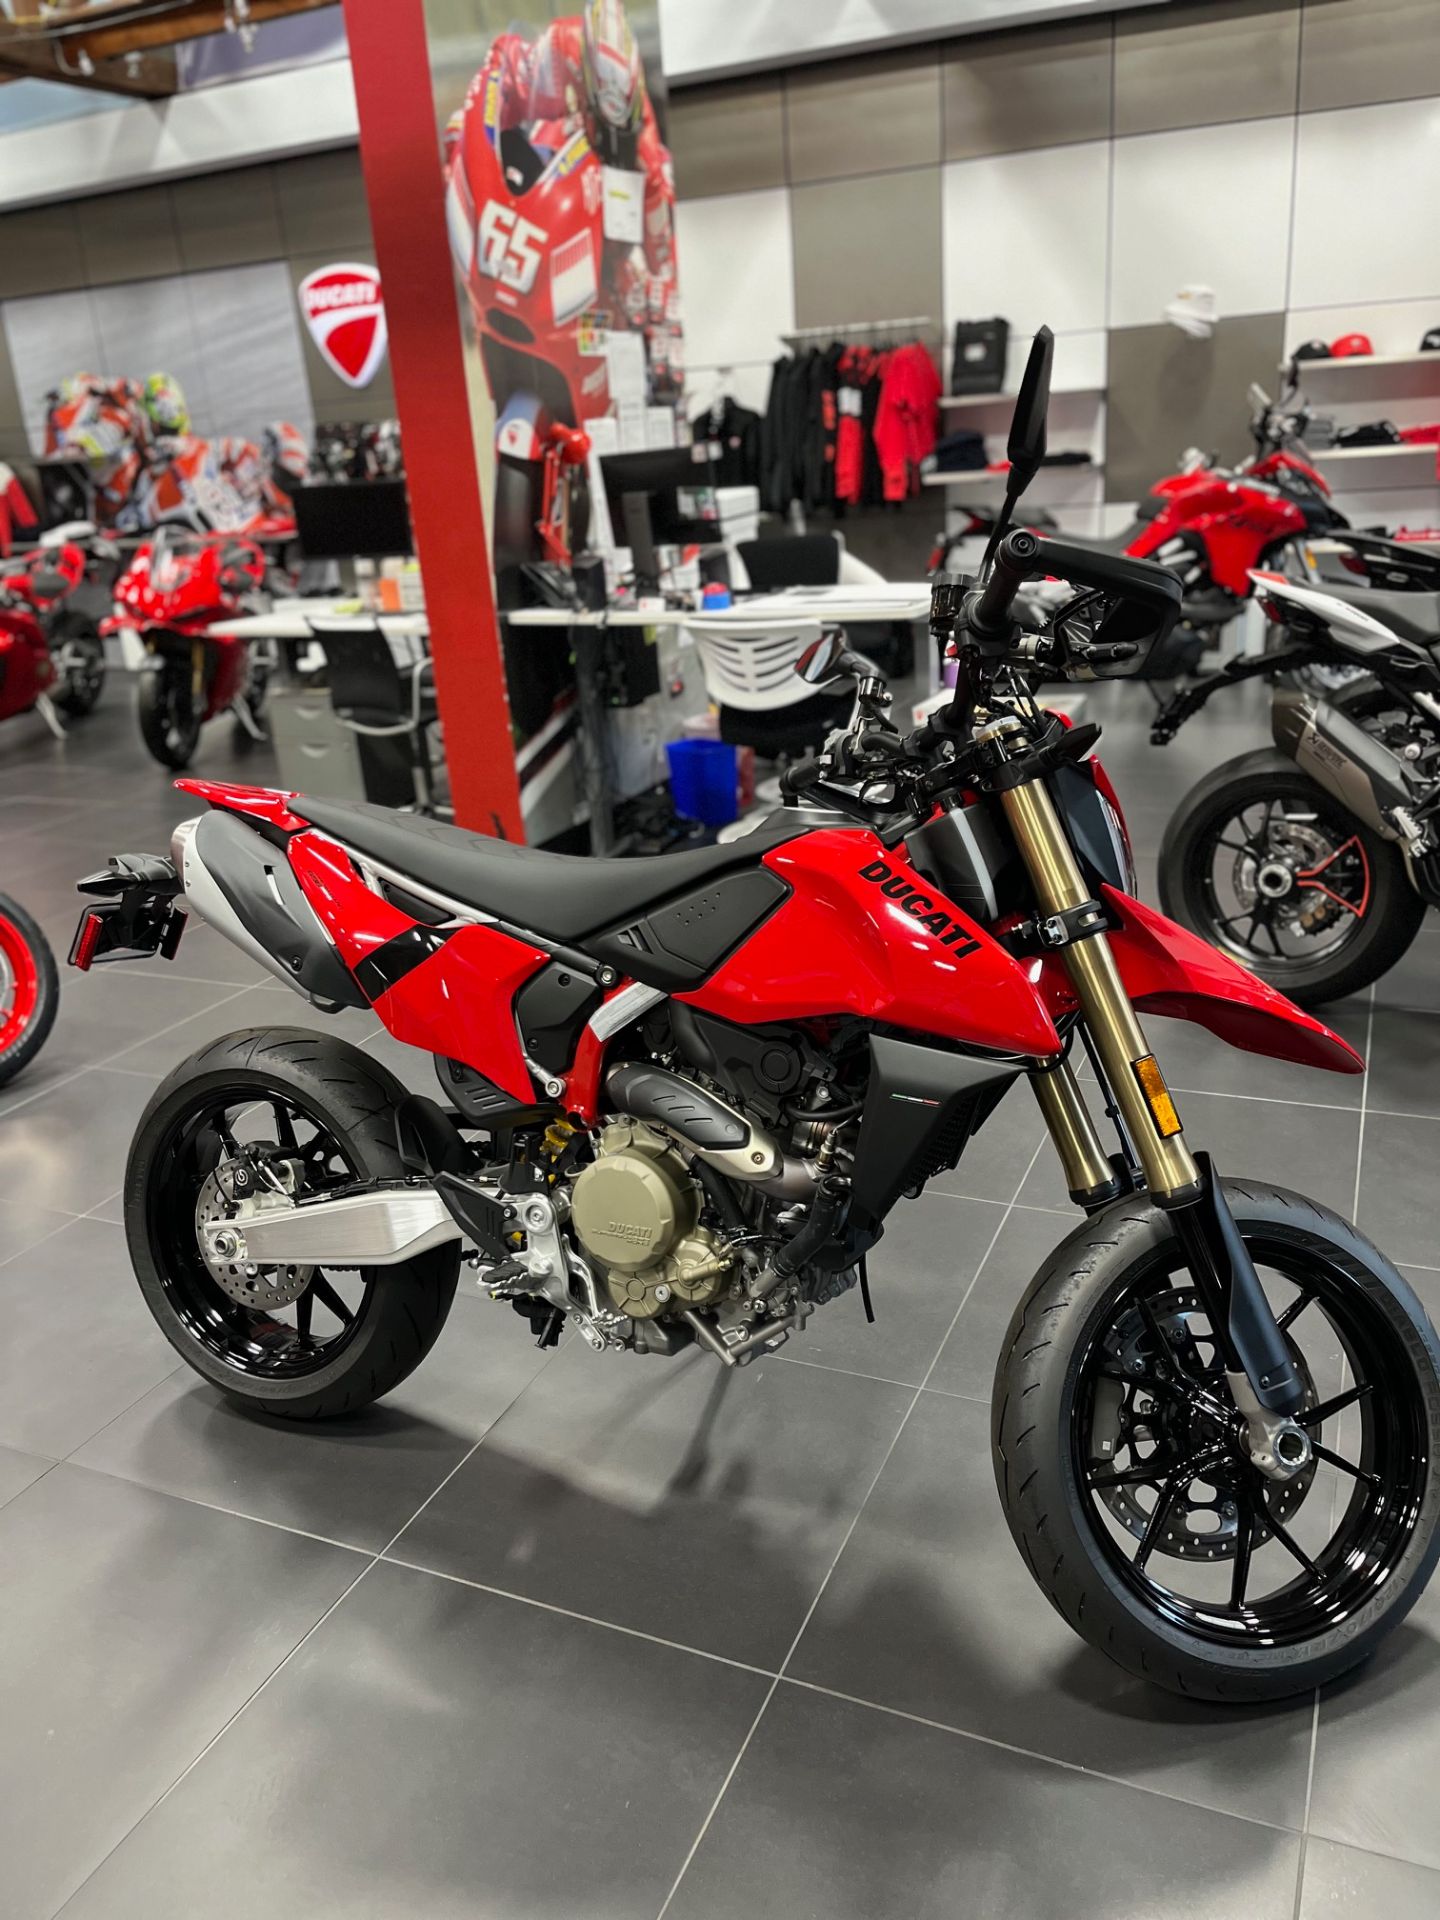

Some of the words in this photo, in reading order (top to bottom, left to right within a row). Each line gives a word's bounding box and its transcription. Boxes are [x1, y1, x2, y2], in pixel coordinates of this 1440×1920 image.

[478, 199, 549, 294] 65
[304, 282, 377, 310] DUCATI
[857, 860, 983, 959] DUCATI
[608, 1221, 653, 1239] DUCATI
